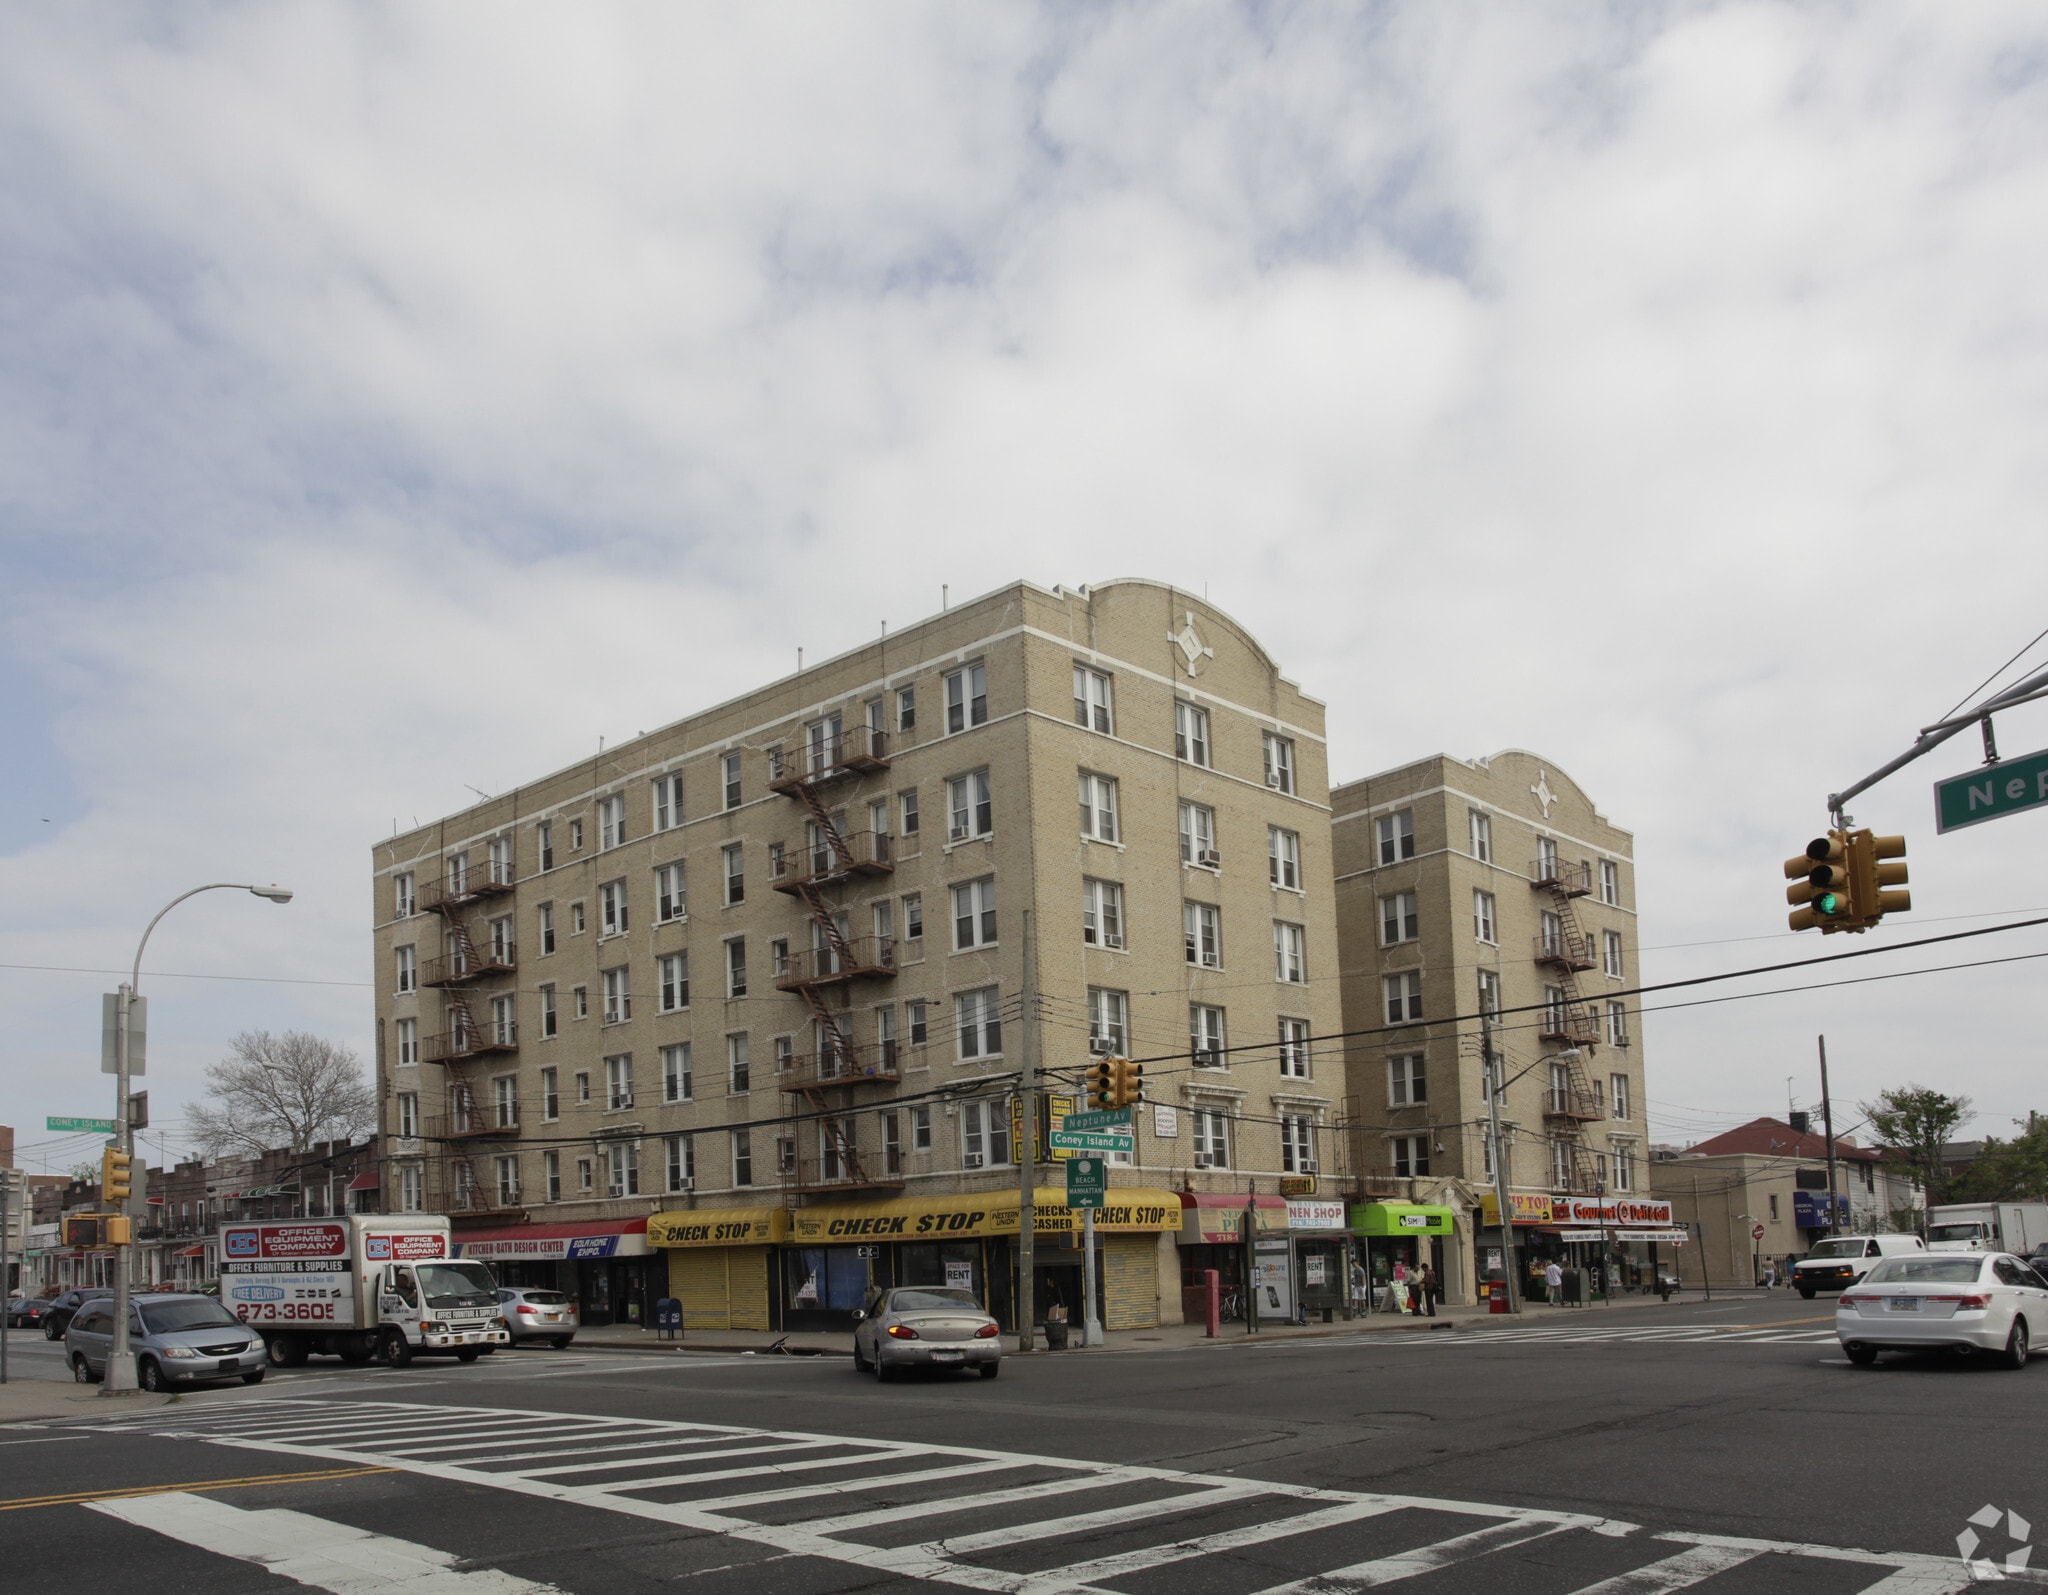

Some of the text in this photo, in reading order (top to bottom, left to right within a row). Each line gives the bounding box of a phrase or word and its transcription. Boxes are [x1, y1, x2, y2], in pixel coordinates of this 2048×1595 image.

[50, 1118, 112, 1129] CONEY ISLAND
[1069, 1115, 1111, 1130] Neptune
[1113, 1111, 1126, 1121] Av
[1055, 1134, 1130, 1148] Coney Island Av
[1075, 1176, 1096, 1184] BEACH
[1069, 1187, 1102, 1195] MANHATTAN
[1526, 1196, 1549, 1210] TOP
[992, 1210, 1020, 1220] WESTERN
[1034, 1206, 1072, 1216] CHECKS
[1093, 1207, 1131, 1224] CHECK
[1136, 1206, 1165, 1224] $TOP
[1314, 1208, 1341, 1219] SHOP
[1574, 1202, 1616, 1220] Gourmet
[829, 1211, 985, 1236] CHECK $TOP
[996, 1218, 1015, 1226] UNION
[1033, 1218, 1072, 1229] CASHED
[1223, 1219, 1268, 1231] PIA
[278, 1228, 324, 1236] OFFICE
[666, 1225, 709, 1241] CHECK
[715, 1222, 751, 1240] $TOP
[264, 1234, 340, 1244] EQUIPMENT
[269, 1242, 336, 1251] COMPANY
[468, 1240, 564, 1255] KITCHEN BATH DESIGN CENTER
[1487, 1249, 1499, 1257] RENT
[228, 1261, 342, 1272] OFFICE FURNITURE & SUPPLIES
[1307, 1262, 1323, 1271] RENT
[947, 1270, 970, 1280] RENT
[234, 1288, 282, 1300] FREE DELIVERY
[453, 1310, 474, 1319] FURNITURE
[480, 1308, 497, 1317] SUPPLIES
